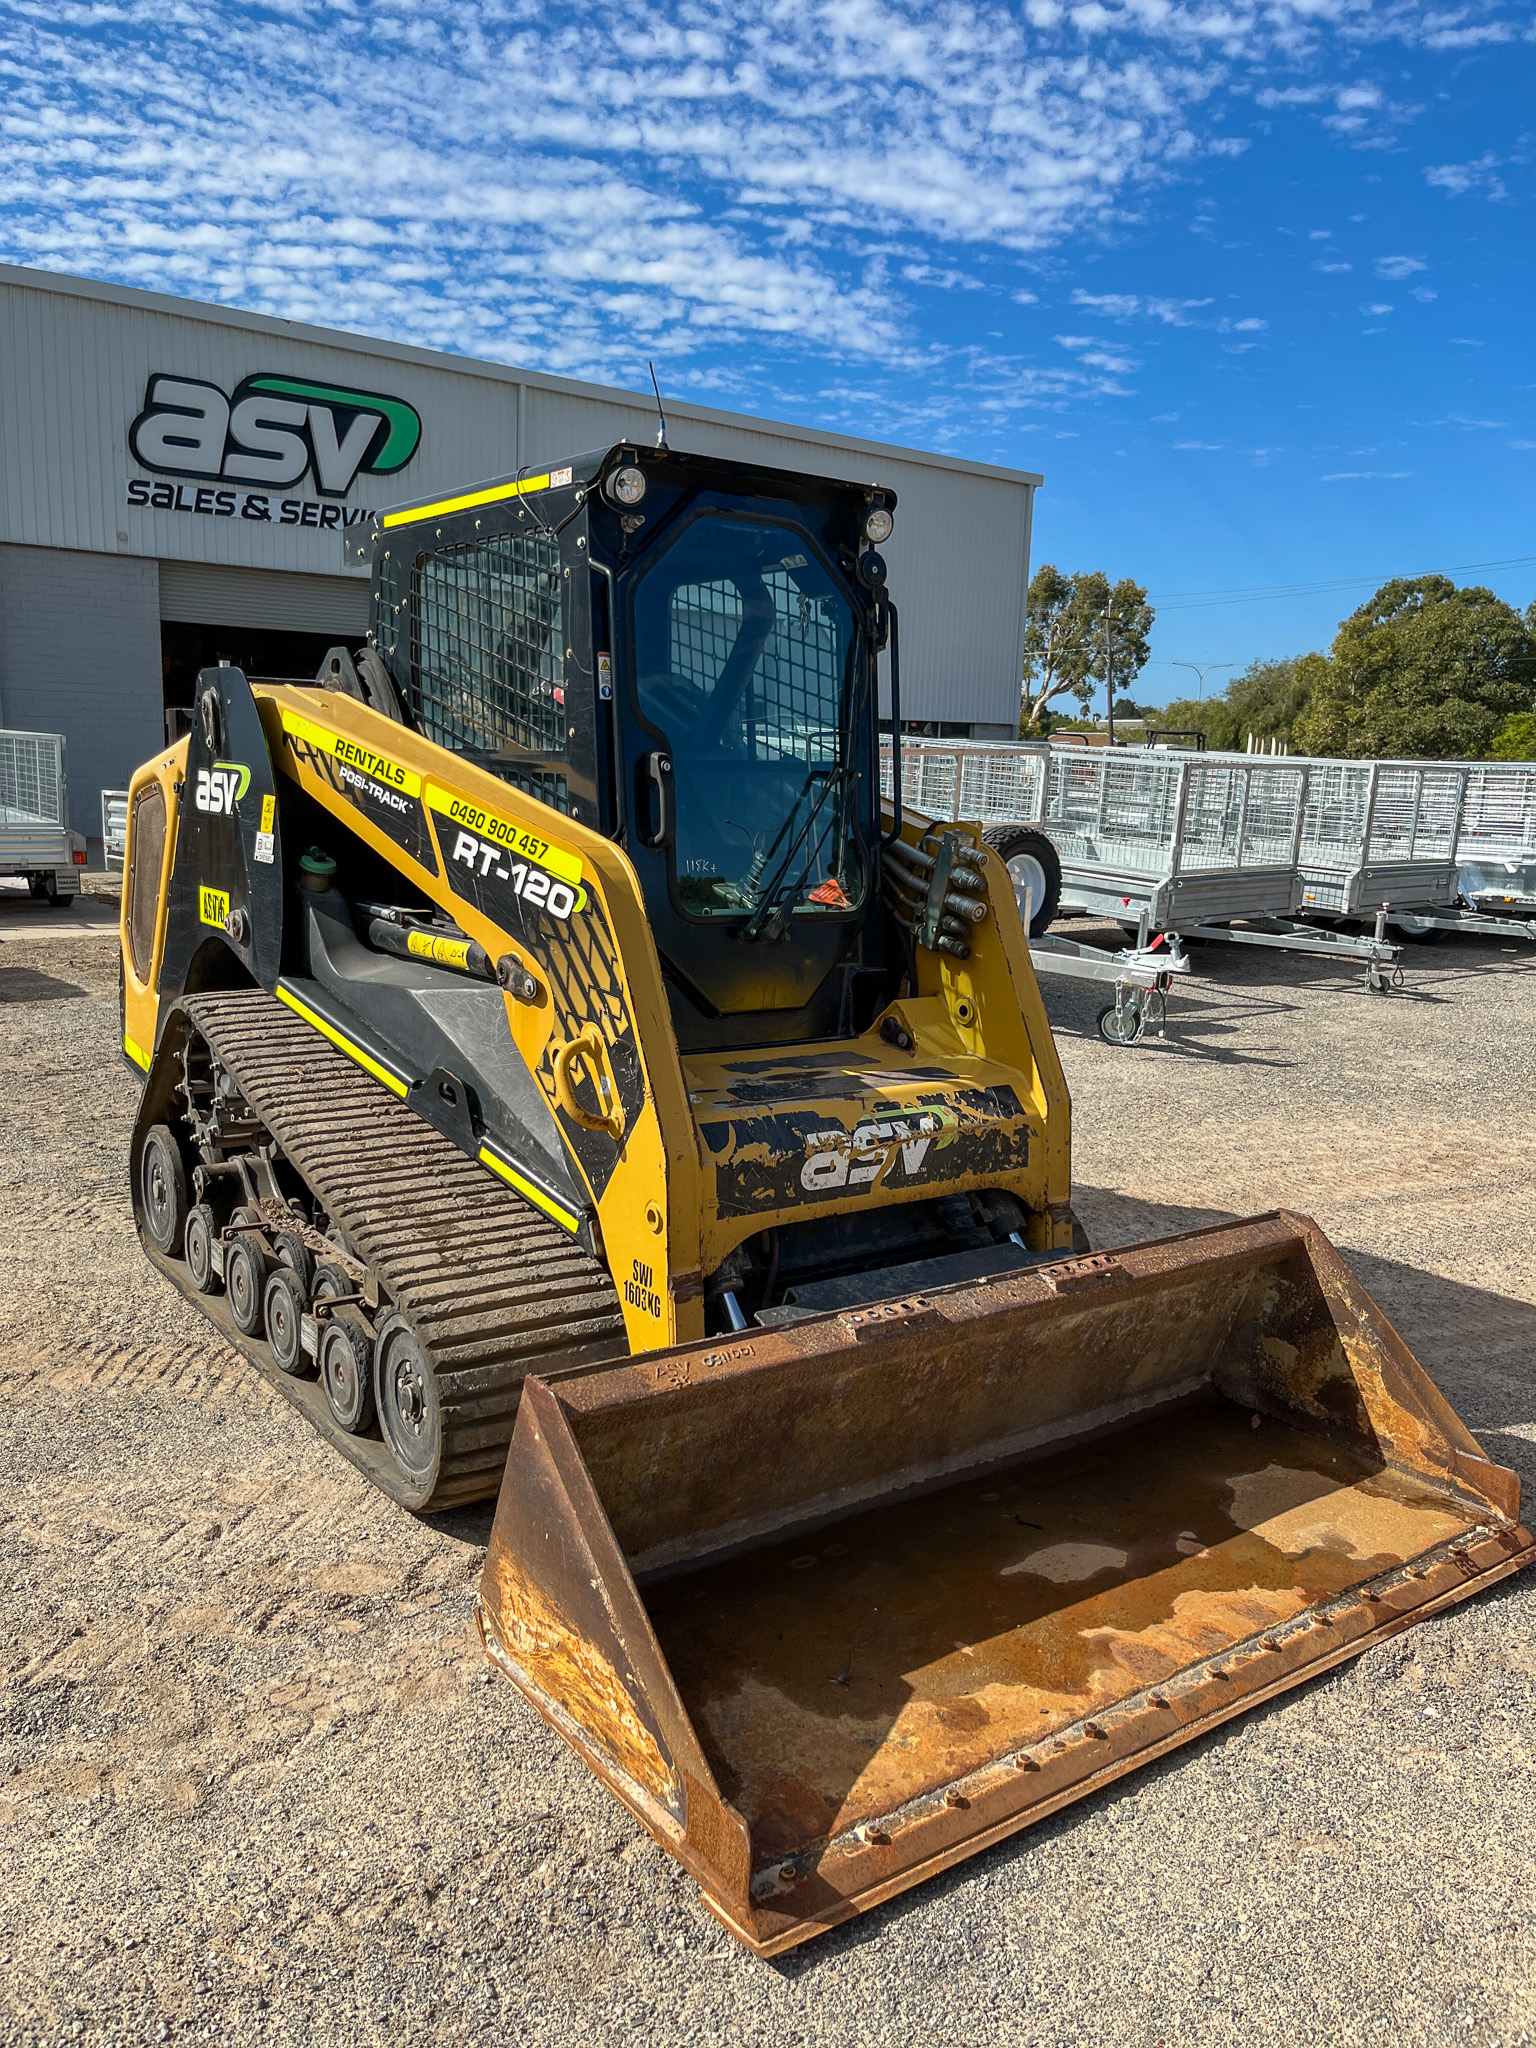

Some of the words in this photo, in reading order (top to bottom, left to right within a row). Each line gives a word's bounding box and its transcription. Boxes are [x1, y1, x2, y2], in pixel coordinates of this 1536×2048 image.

[241, 494, 273, 521] &
[280, 500, 377, 530] SERVI
[334, 738, 406, 785] RENTALS
[338, 765, 409, 814] POSI-TRACK
[450, 800, 486, 829] 0490
[487, 819, 517, 844] 900
[519, 835, 549, 859] 457
[452, 830, 574, 919] RT-120
[632, 1258, 653, 1288] SWI
[623, 1279, 661, 1318] 1603KG
